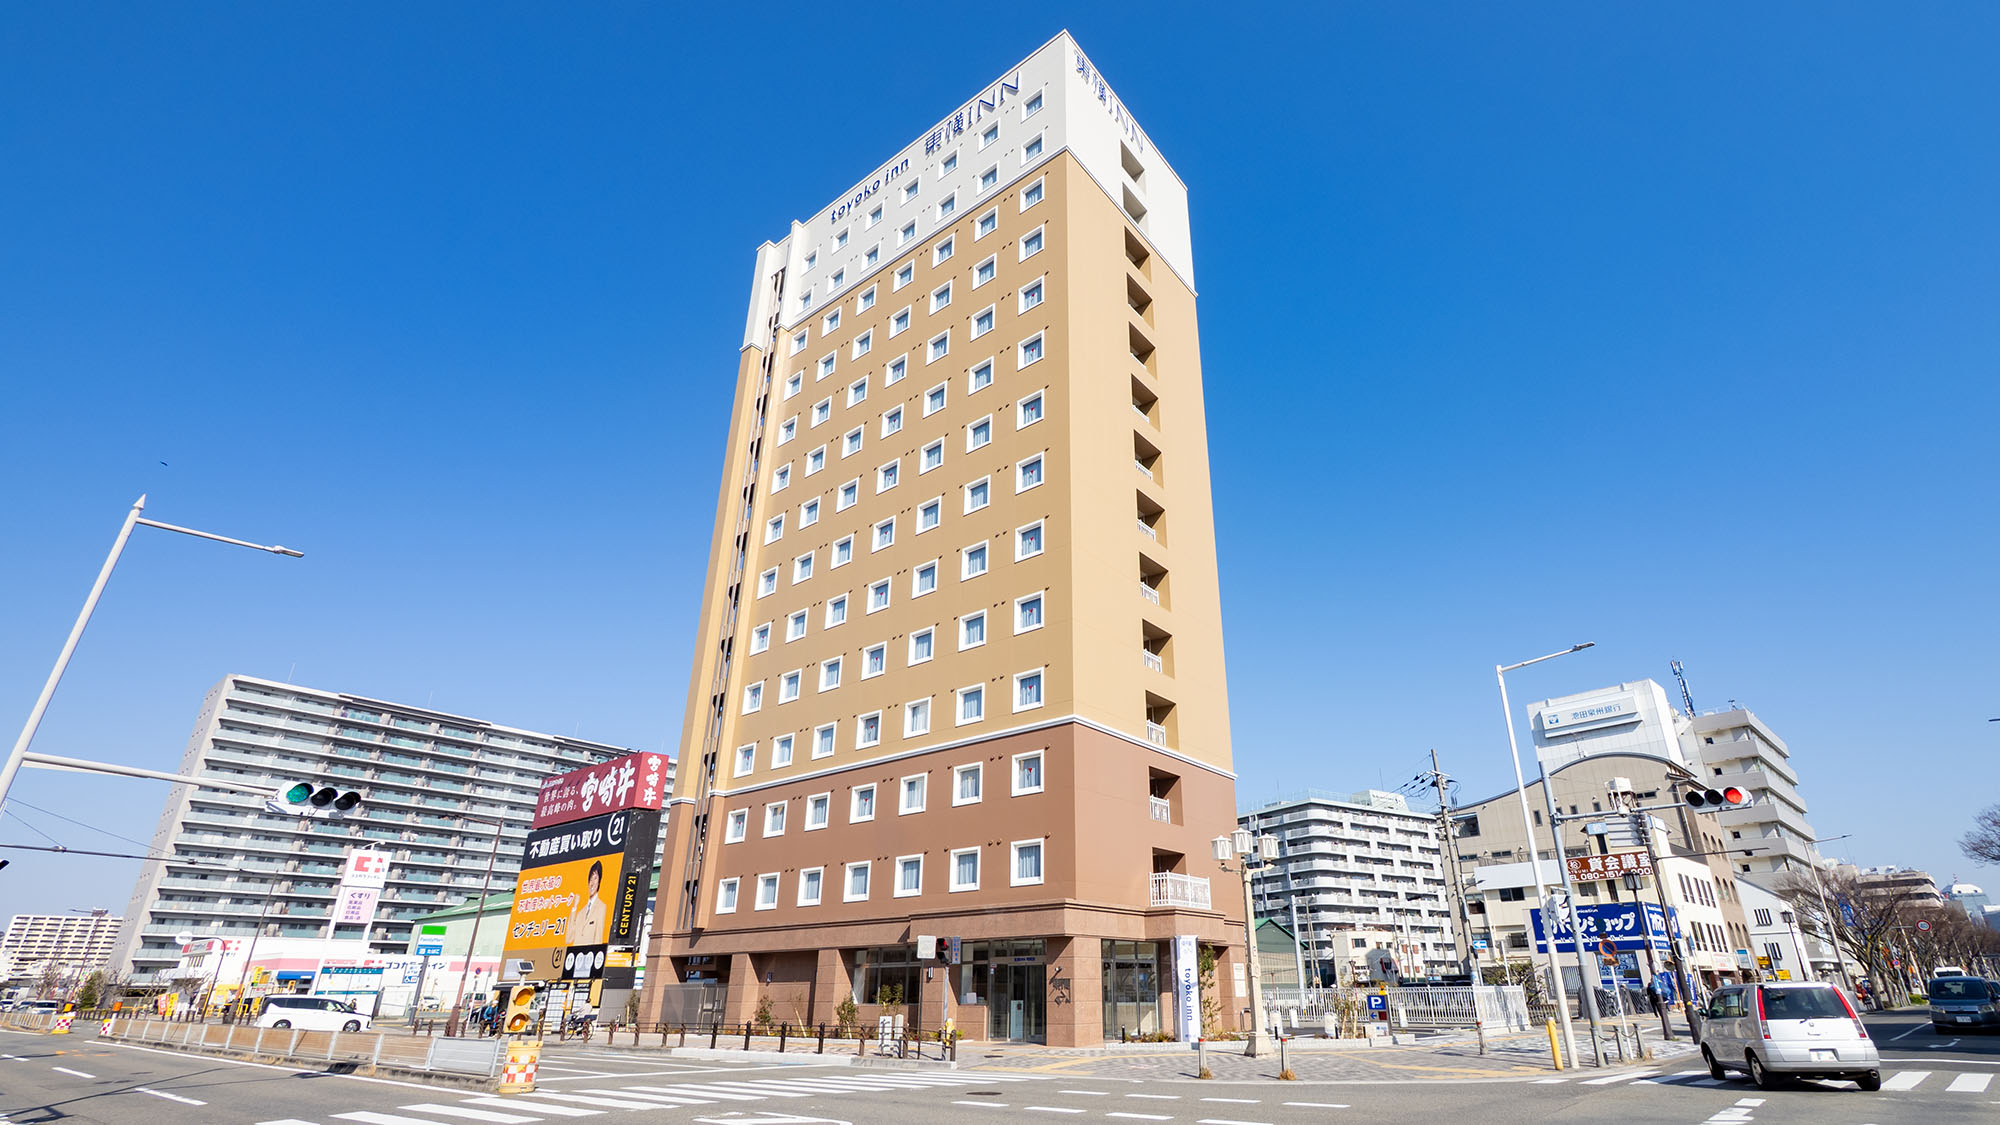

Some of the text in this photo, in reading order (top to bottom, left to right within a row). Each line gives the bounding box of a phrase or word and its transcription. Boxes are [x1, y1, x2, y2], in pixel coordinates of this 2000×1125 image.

[924, 71, 1020, 155] 東横INN
[1074, 50, 1144, 153] 東横INN
[830, 157, 909, 225] toyoko inn
[581, 759, 636, 812] 宮崎牛
[529, 828, 602, 859] 不動産買い取り
[1587, 852, 1650, 872] 貸会議室
[350, 892, 371, 900] くすり
[619, 875, 638, 935] CENTURY 21
[512, 916, 567, 939] センチュリー21
[1184, 968, 1192, 1003] toyoko
[1370, 996, 1382, 1009] P
